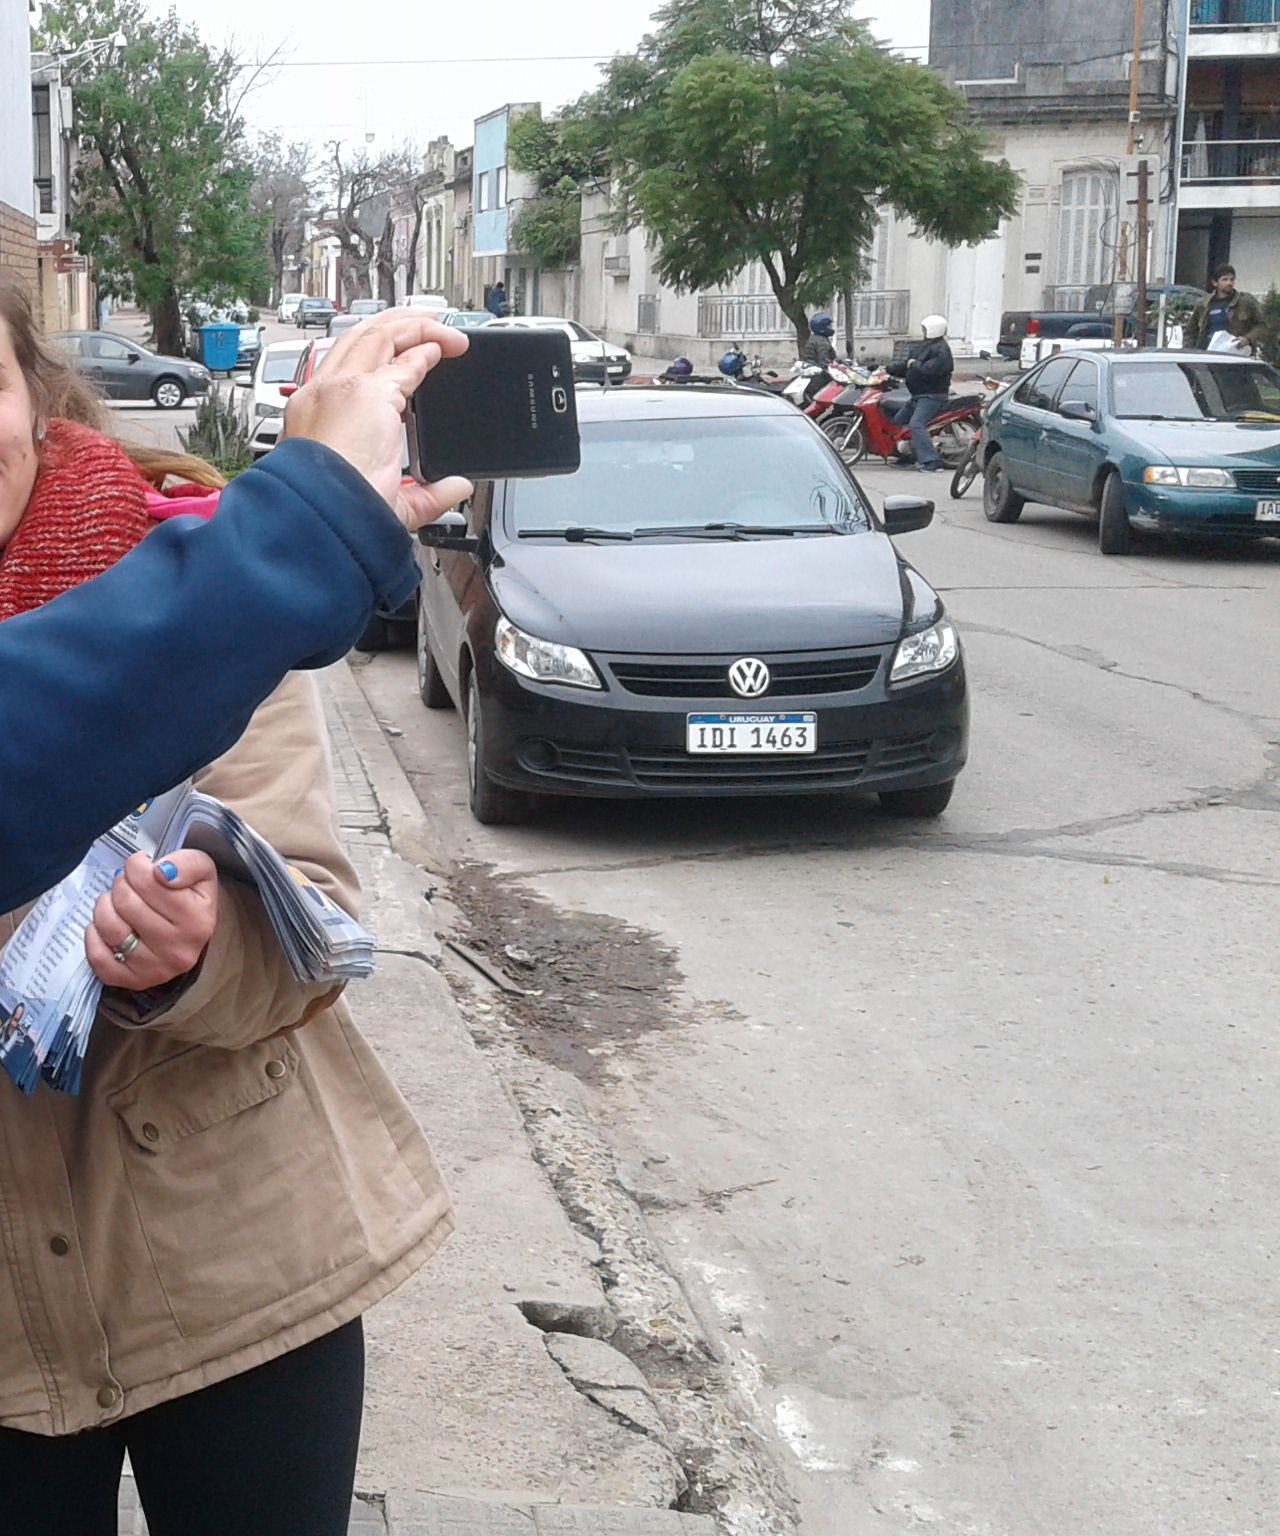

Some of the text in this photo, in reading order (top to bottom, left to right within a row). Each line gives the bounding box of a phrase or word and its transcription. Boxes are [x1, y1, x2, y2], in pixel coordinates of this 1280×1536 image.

[728, 715, 776, 723] URUGUAY
[697, 727, 807, 748] IDI 1463
